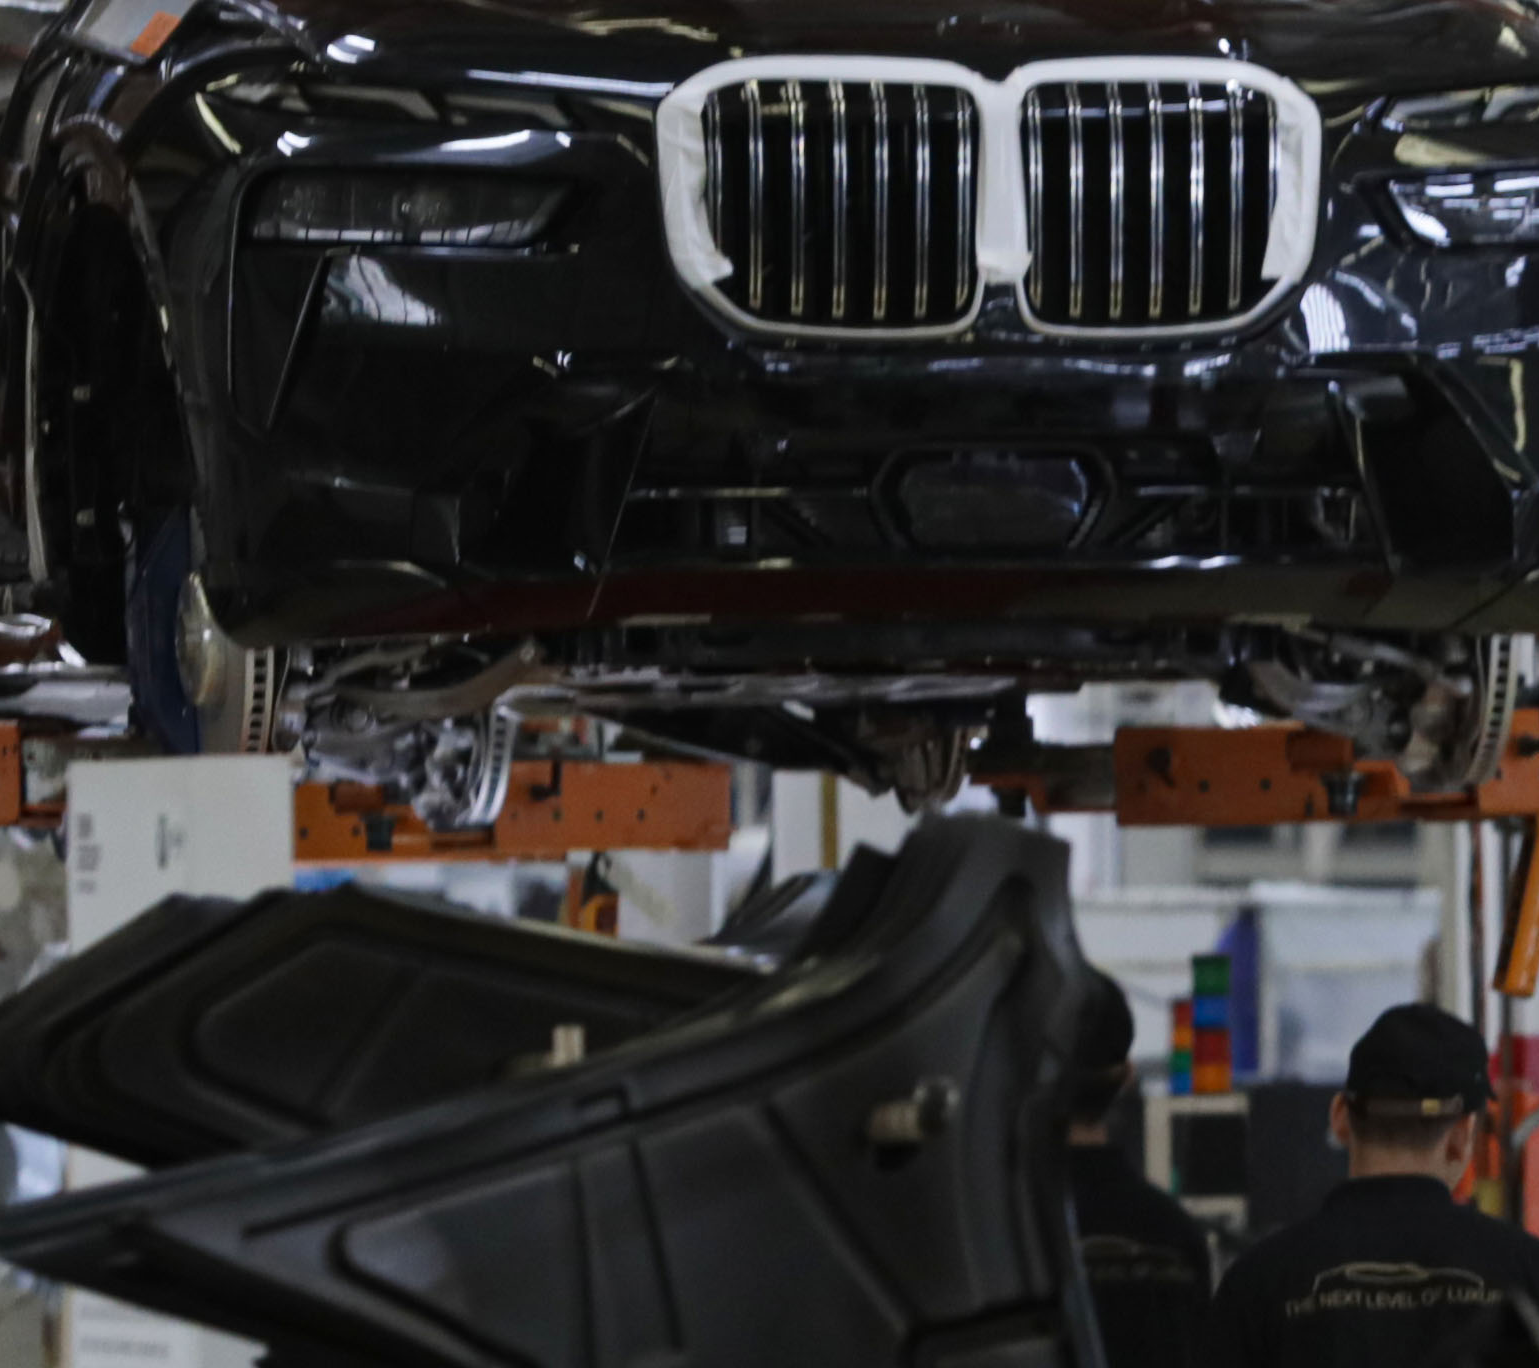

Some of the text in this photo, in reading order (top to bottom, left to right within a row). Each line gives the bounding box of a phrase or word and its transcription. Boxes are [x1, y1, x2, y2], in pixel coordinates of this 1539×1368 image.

[1319, 1288, 1362, 1310] NEXT
[1365, 1290, 1418, 1312] LEVEL
[1446, 1283, 1504, 1306] LUXUR
